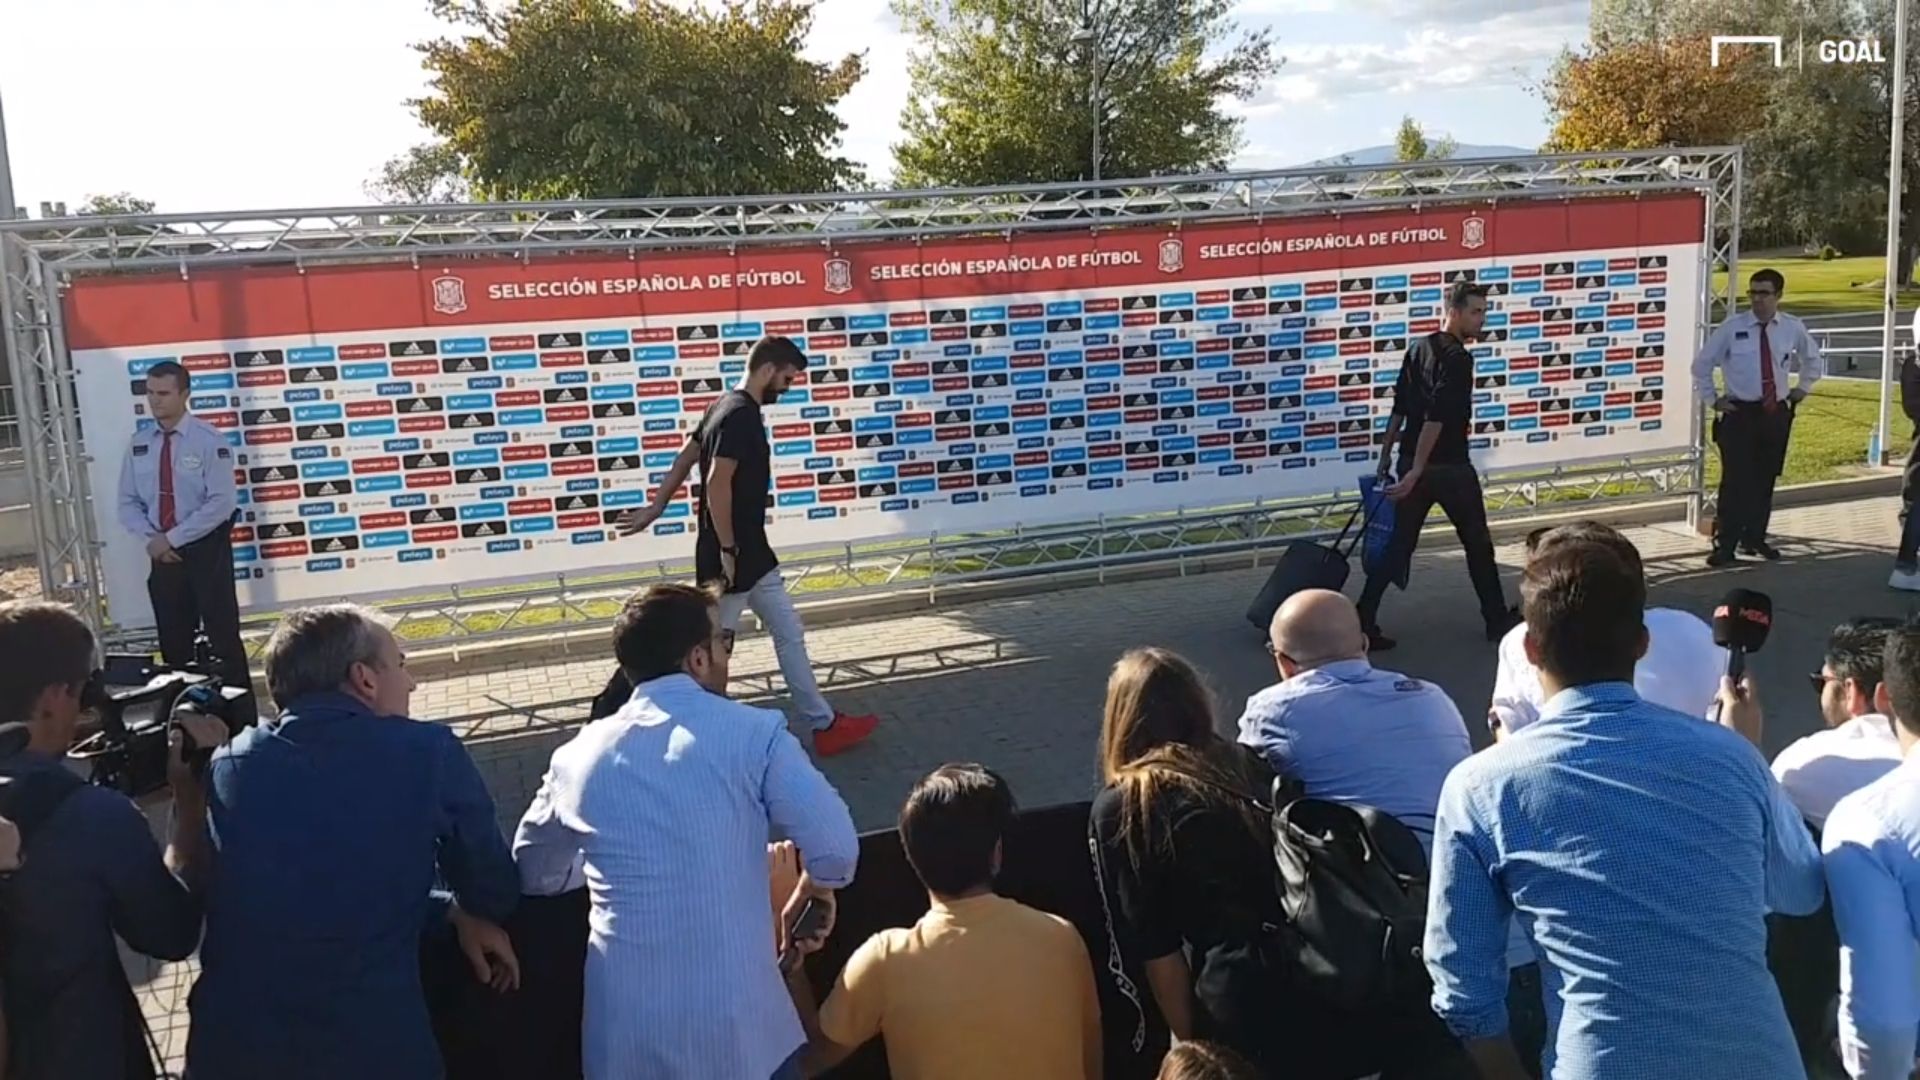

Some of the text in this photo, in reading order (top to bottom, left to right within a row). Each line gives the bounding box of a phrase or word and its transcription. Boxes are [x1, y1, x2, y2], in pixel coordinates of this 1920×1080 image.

[1200, 226, 1448, 260] SELECCIÓN ESPAÑOLA DE FÚTBOL
[870, 248, 1142, 280] SELECCIÓN ESPAÑOLA DE FÚTBOL
[488, 267, 806, 300] SELECCIÓN ESPAÑOLA DE FÚTBOL
